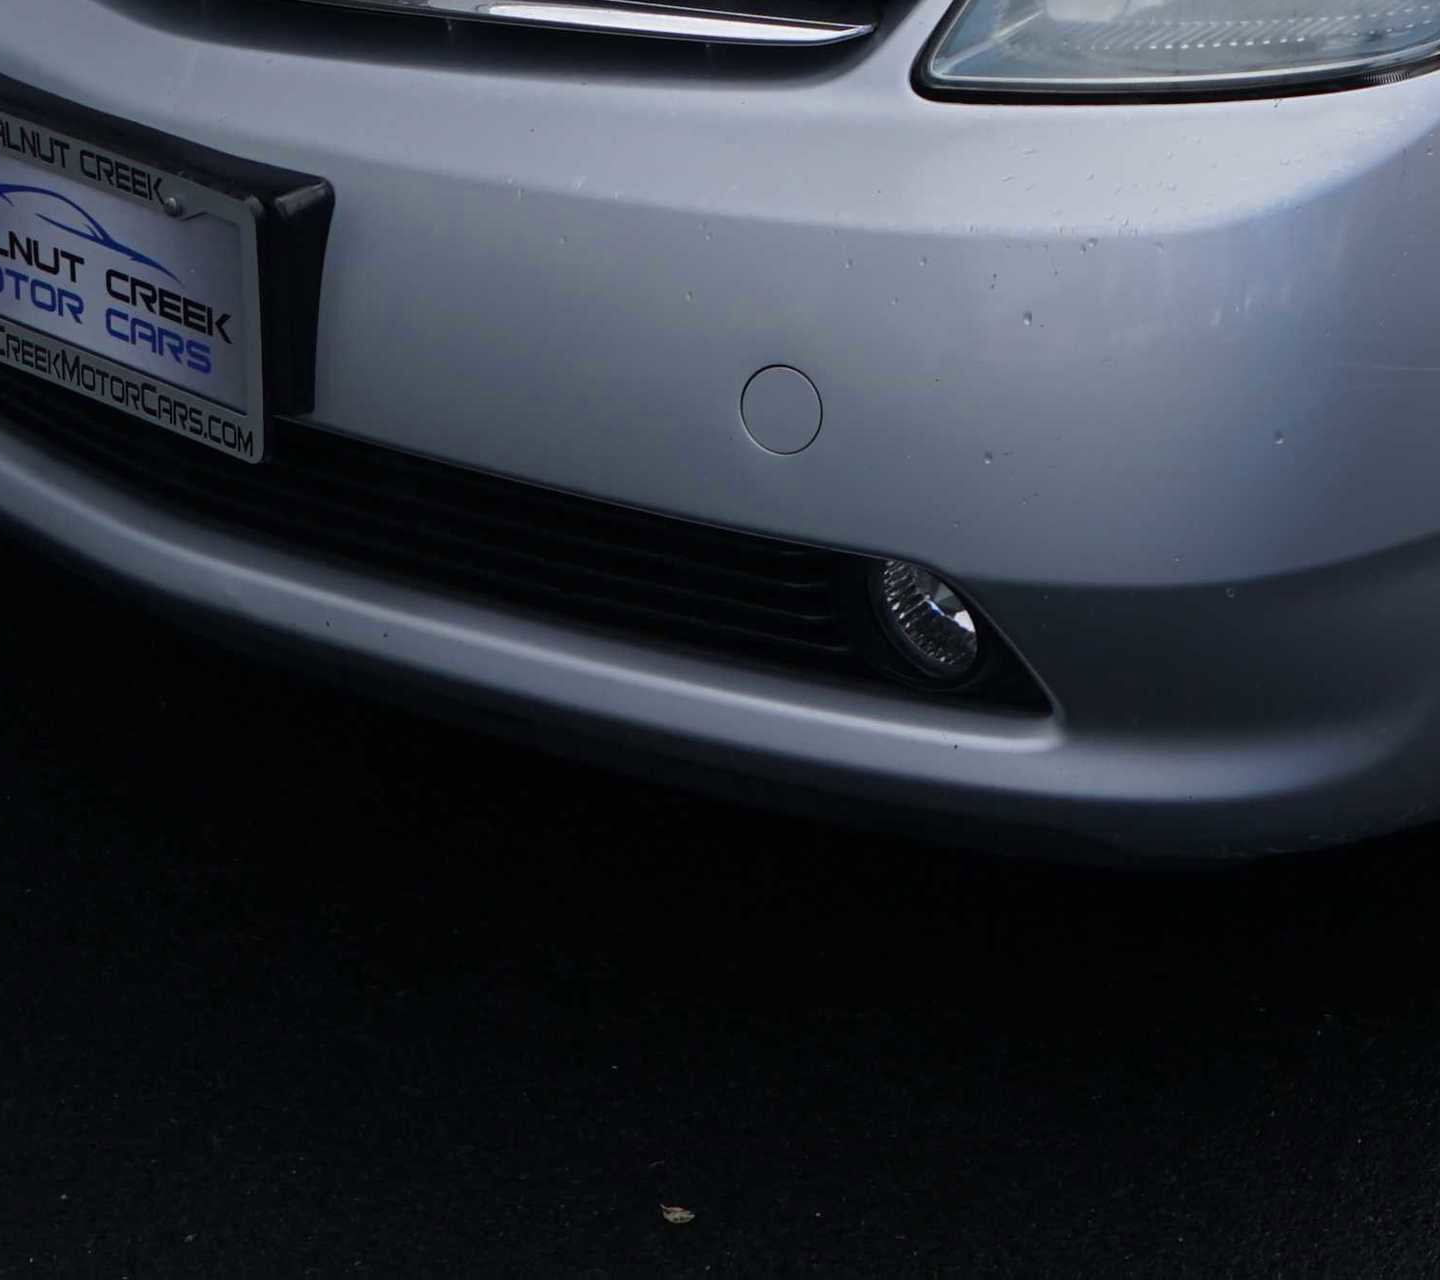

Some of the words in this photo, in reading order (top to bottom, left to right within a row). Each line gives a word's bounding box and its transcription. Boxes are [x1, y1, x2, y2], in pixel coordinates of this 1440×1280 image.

[79, 148, 166, 205] CREEK
[105, 267, 233, 345] CREEK
[105, 306, 213, 375] CARS
